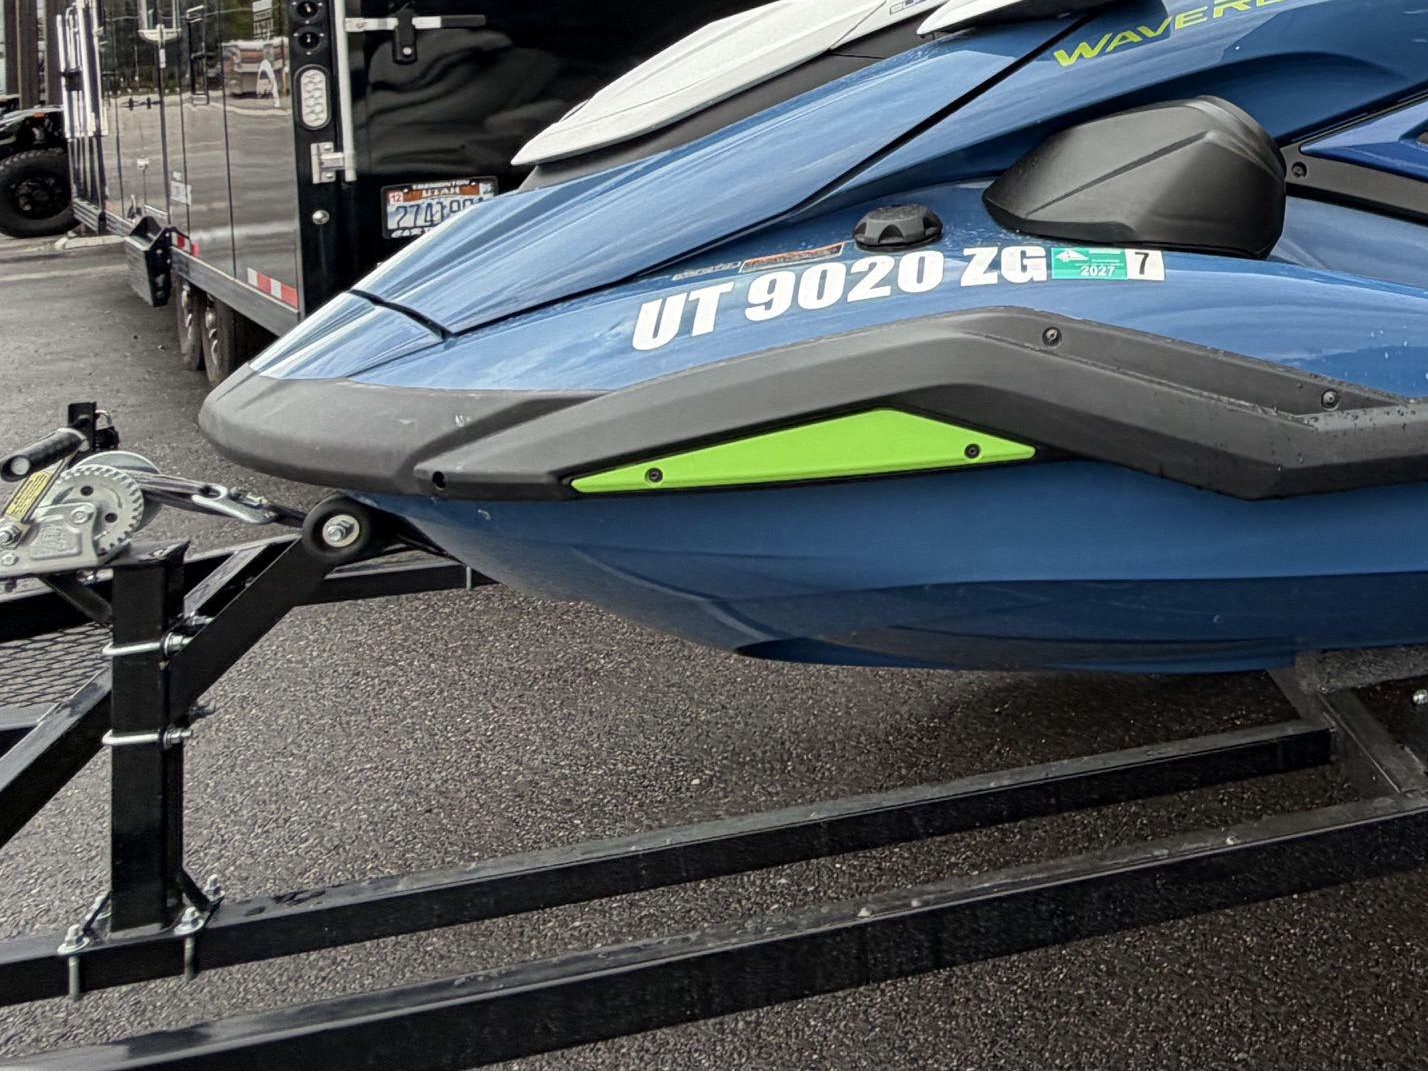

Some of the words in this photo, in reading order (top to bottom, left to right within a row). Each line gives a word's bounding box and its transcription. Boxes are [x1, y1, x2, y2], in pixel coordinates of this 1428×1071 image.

[422, 186, 461, 197] UTAH
[1080, 265, 1116, 277] 2027
[1134, 251, 1150, 275] 7
[632, 282, 735, 351] UT
[744, 249, 944, 321] 9020
[960, 245, 1047, 288] ZG
